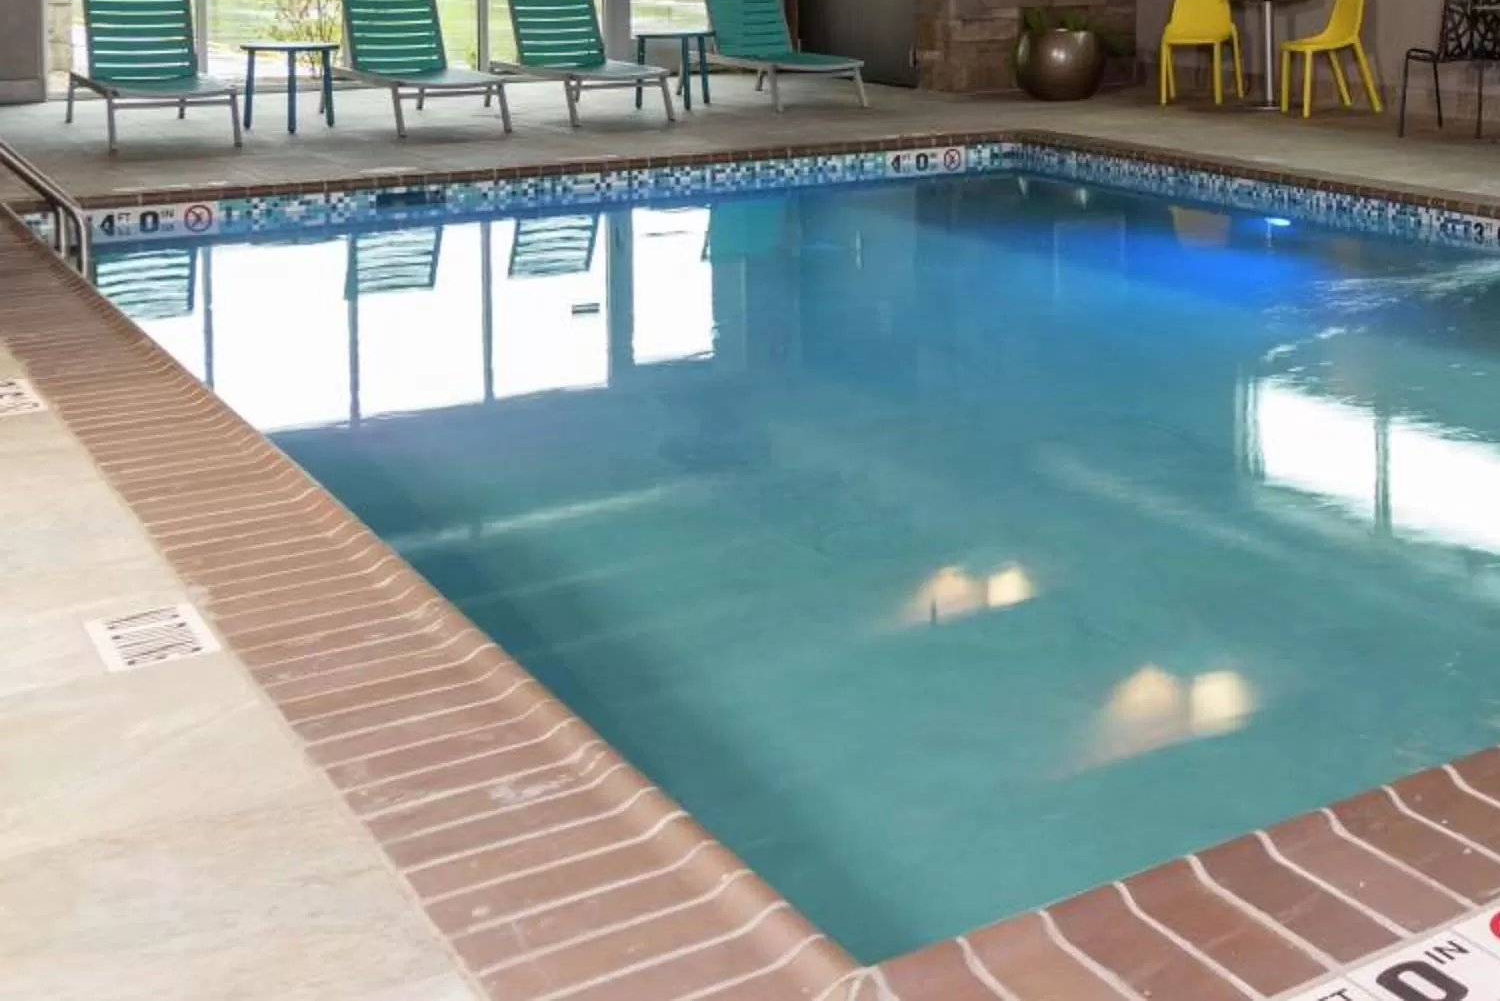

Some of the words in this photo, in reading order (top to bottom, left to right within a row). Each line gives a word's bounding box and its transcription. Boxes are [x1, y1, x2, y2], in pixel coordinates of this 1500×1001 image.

[916, 153, 929, 171] 0
[100, 215, 115, 236] 4
[140, 211, 159, 234] 0
[1376, 961, 1469, 1001] 0
[1424, 940, 1470, 965] IN
